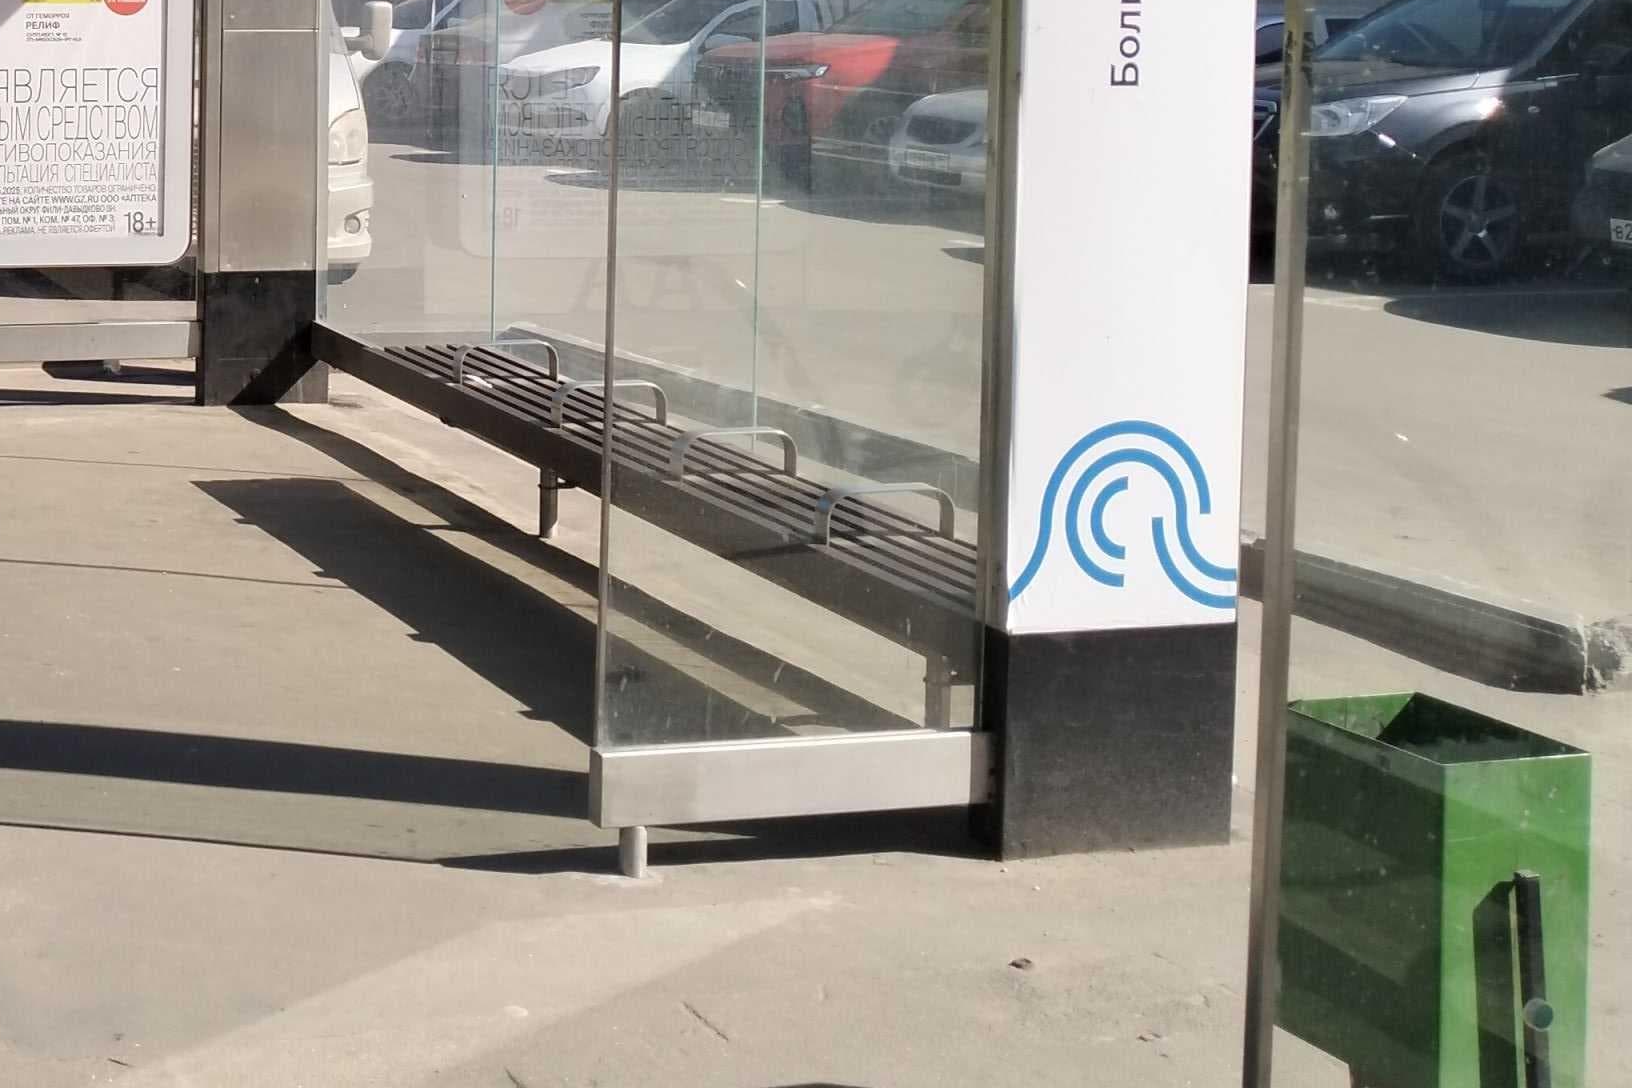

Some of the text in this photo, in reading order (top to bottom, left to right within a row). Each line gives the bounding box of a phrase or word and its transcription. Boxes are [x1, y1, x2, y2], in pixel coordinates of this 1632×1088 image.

[25, 21, 60, 30] РЕЛИФ
[37, 104, 158, 141] СРЕДСТВОМ
[64, 162, 157, 183] СПЕЦИАЛИСТА
[123, 211, 157, 233] 18+
